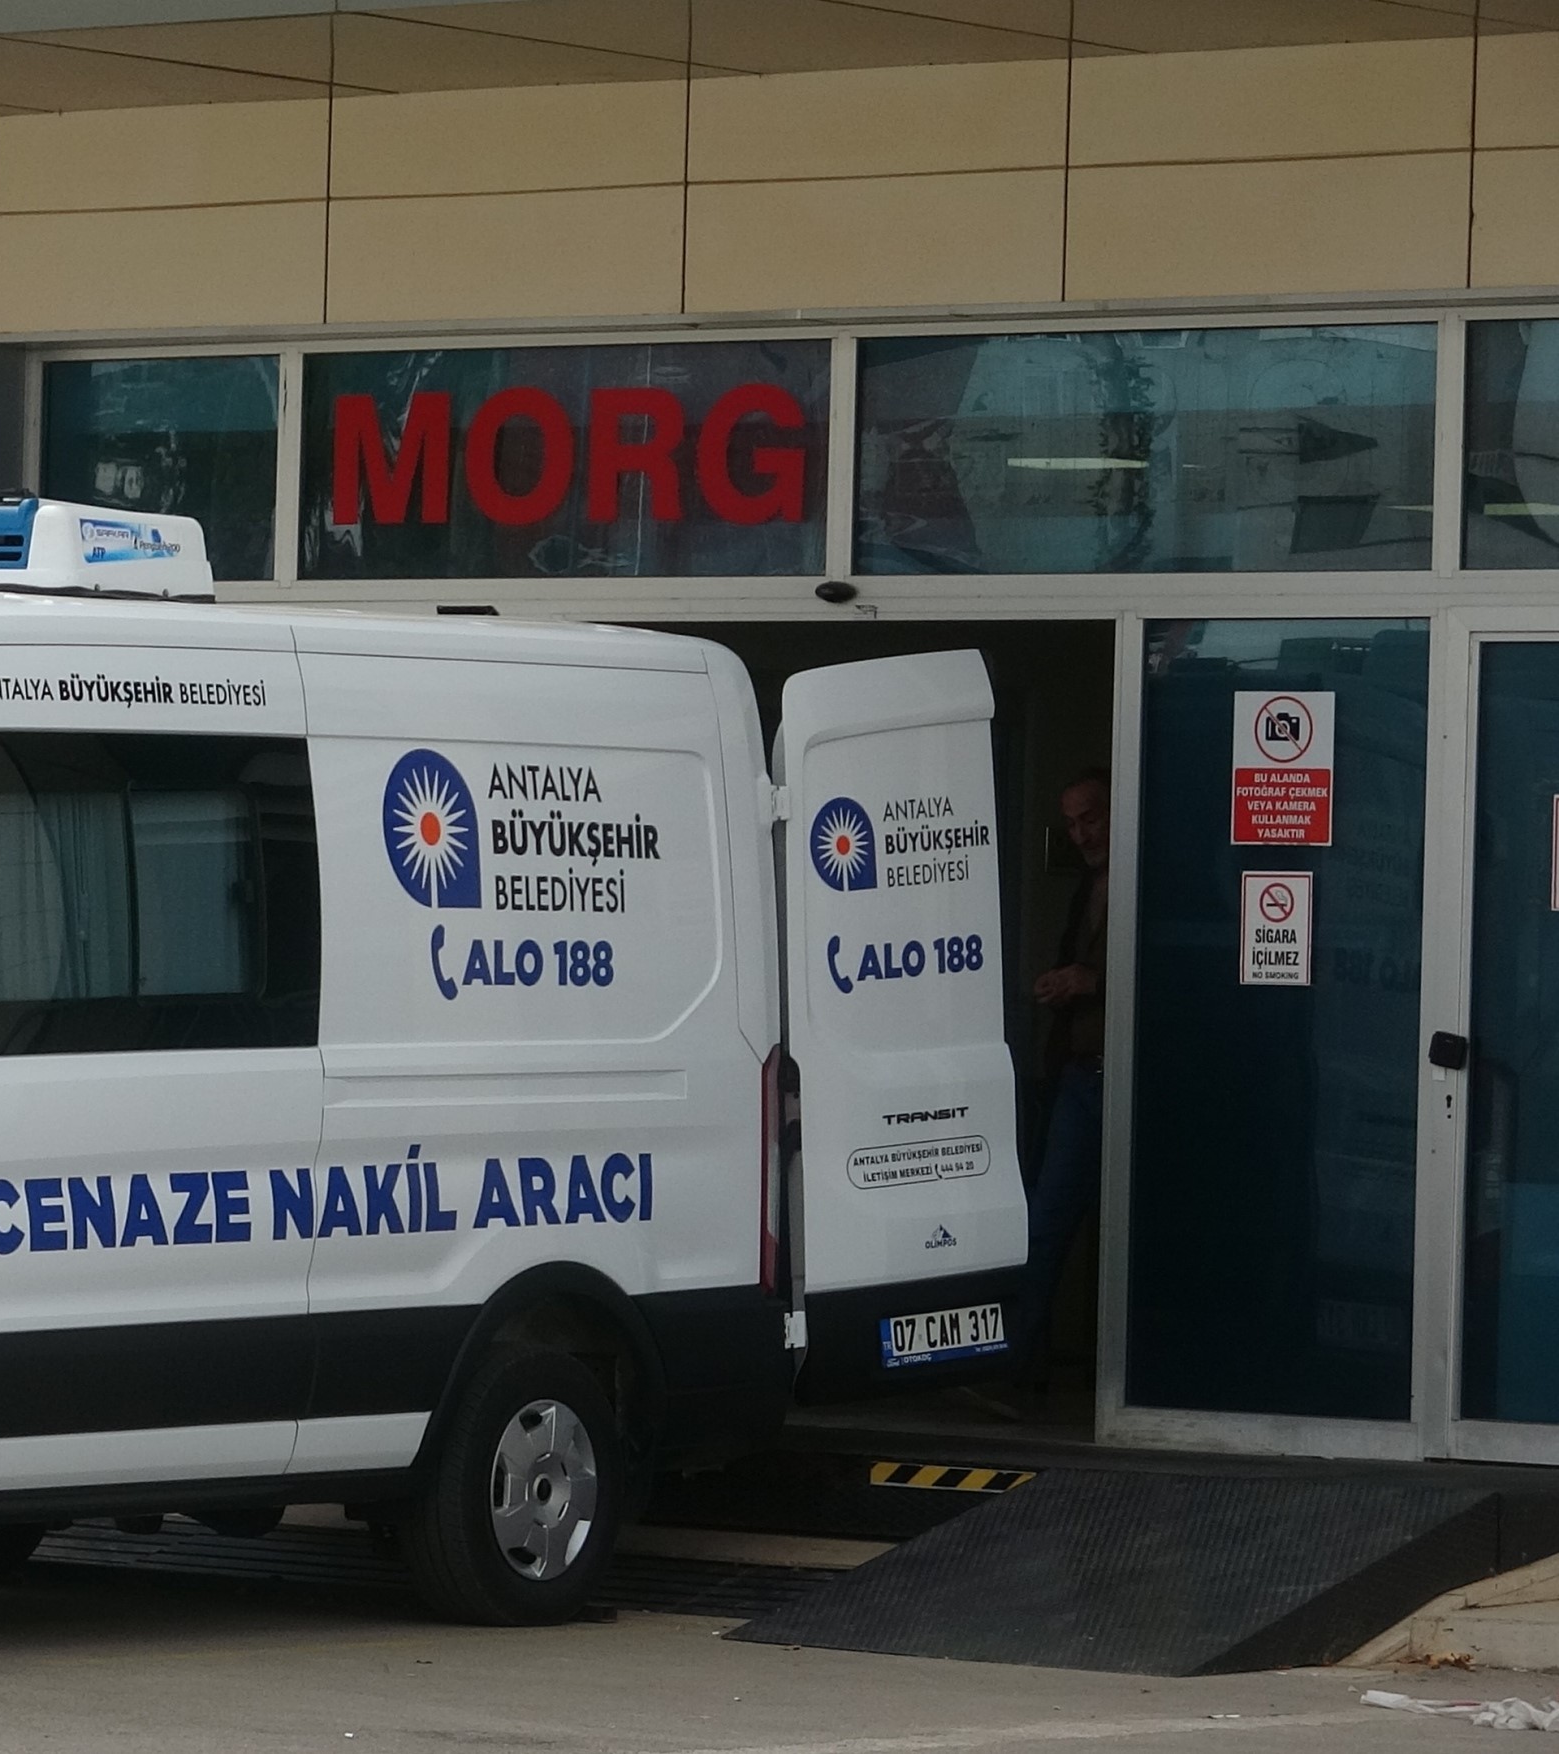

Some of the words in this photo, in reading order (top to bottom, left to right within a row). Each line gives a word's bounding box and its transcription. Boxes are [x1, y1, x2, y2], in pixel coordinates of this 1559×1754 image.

[333, 383, 807, 527] MORG
[59, 674, 174, 708] BÜYÜKŞEHİR
[180, 678, 267, 706] BELEDİYESİ
[488, 762, 602, 803] ANTALYA
[1254, 773, 1267, 783] BU
[1270, 773, 1310, 783] ALANDA
[1236, 785, 1286, 797] FOTOĞRAF
[1289, 787, 1328, 799] ÇEKMEK
[883, 796, 954, 822] ANTALYA
[1247, 801, 1273, 811] VEYA
[1275, 801, 1316, 811] KAMERA
[1252, 814, 1311, 825] KULLANMAK
[491, 809, 661, 866] BÜYÜKŞEHİR
[885, 819, 991, 855] BÜYÜKŞEHİR
[1257, 828, 1305, 839] YASAKTIR
[887, 854, 970, 888] BELEDİYESİ
[495, 867, 626, 913] BELEDİYESİ
[1255, 925, 1297, 944] SİGARA
[462, 939, 544, 987] ALO
[553, 940, 614, 987] 188
[857, 940, 926, 981] ALO
[933, 934, 984, 974] 188
[1252, 947, 1299, 970] İÇİLMEZ
[1252, 971, 1263, 980] NO
[1265, 971, 1299, 980] SMOKING
[882, 1106, 969, 1126] TRANSIT
[853, 1153, 889, 1167] ANTALYA
[891, 1146, 939, 1162] BÜYÜKŞEHİR
[941, 1142, 983, 1157] BELEDİYESİ
[863, 1168, 897, 1183] İLETİŞİM
[900, 1163, 933, 1178] MERKEZİ
[269, 1144, 457, 1241] NAKİL
[473, 1153, 652, 1230] ARACI
[893, 1318, 916, 1352] 07
[925, 1313, 962, 1349] CAM
[969, 1307, 1000, 1342] 317
